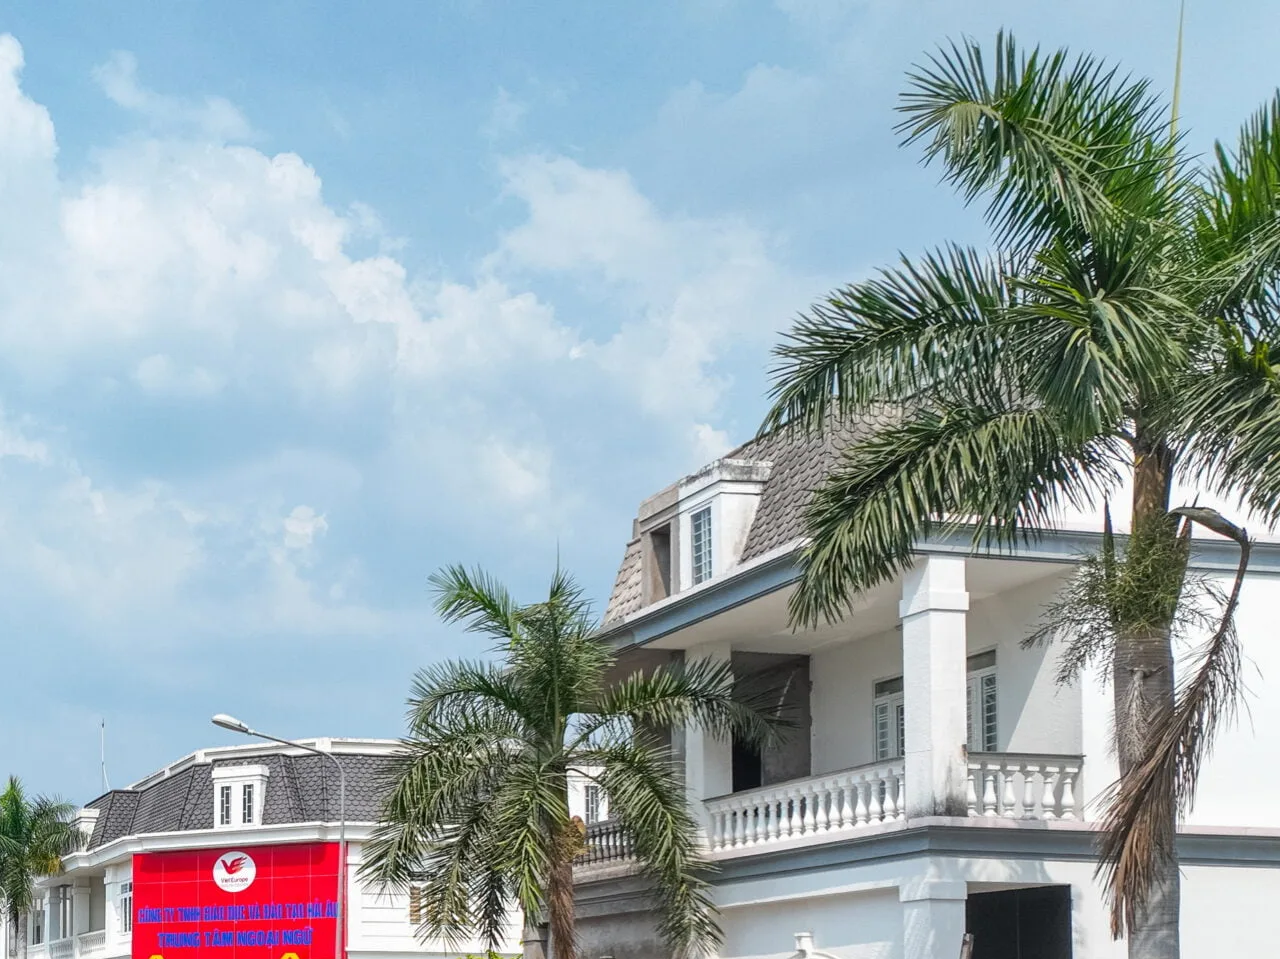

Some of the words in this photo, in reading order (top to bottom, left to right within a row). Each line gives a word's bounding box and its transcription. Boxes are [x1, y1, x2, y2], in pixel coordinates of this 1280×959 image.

[164, 907, 175, 923] TY
[177, 906, 201, 922] TNHH
[157, 931, 201, 948] TRUNG
[204, 928, 234, 947] TÂM
[236, 929, 280, 949] NGOẠI
[282, 926, 314, 945] NGỮ
